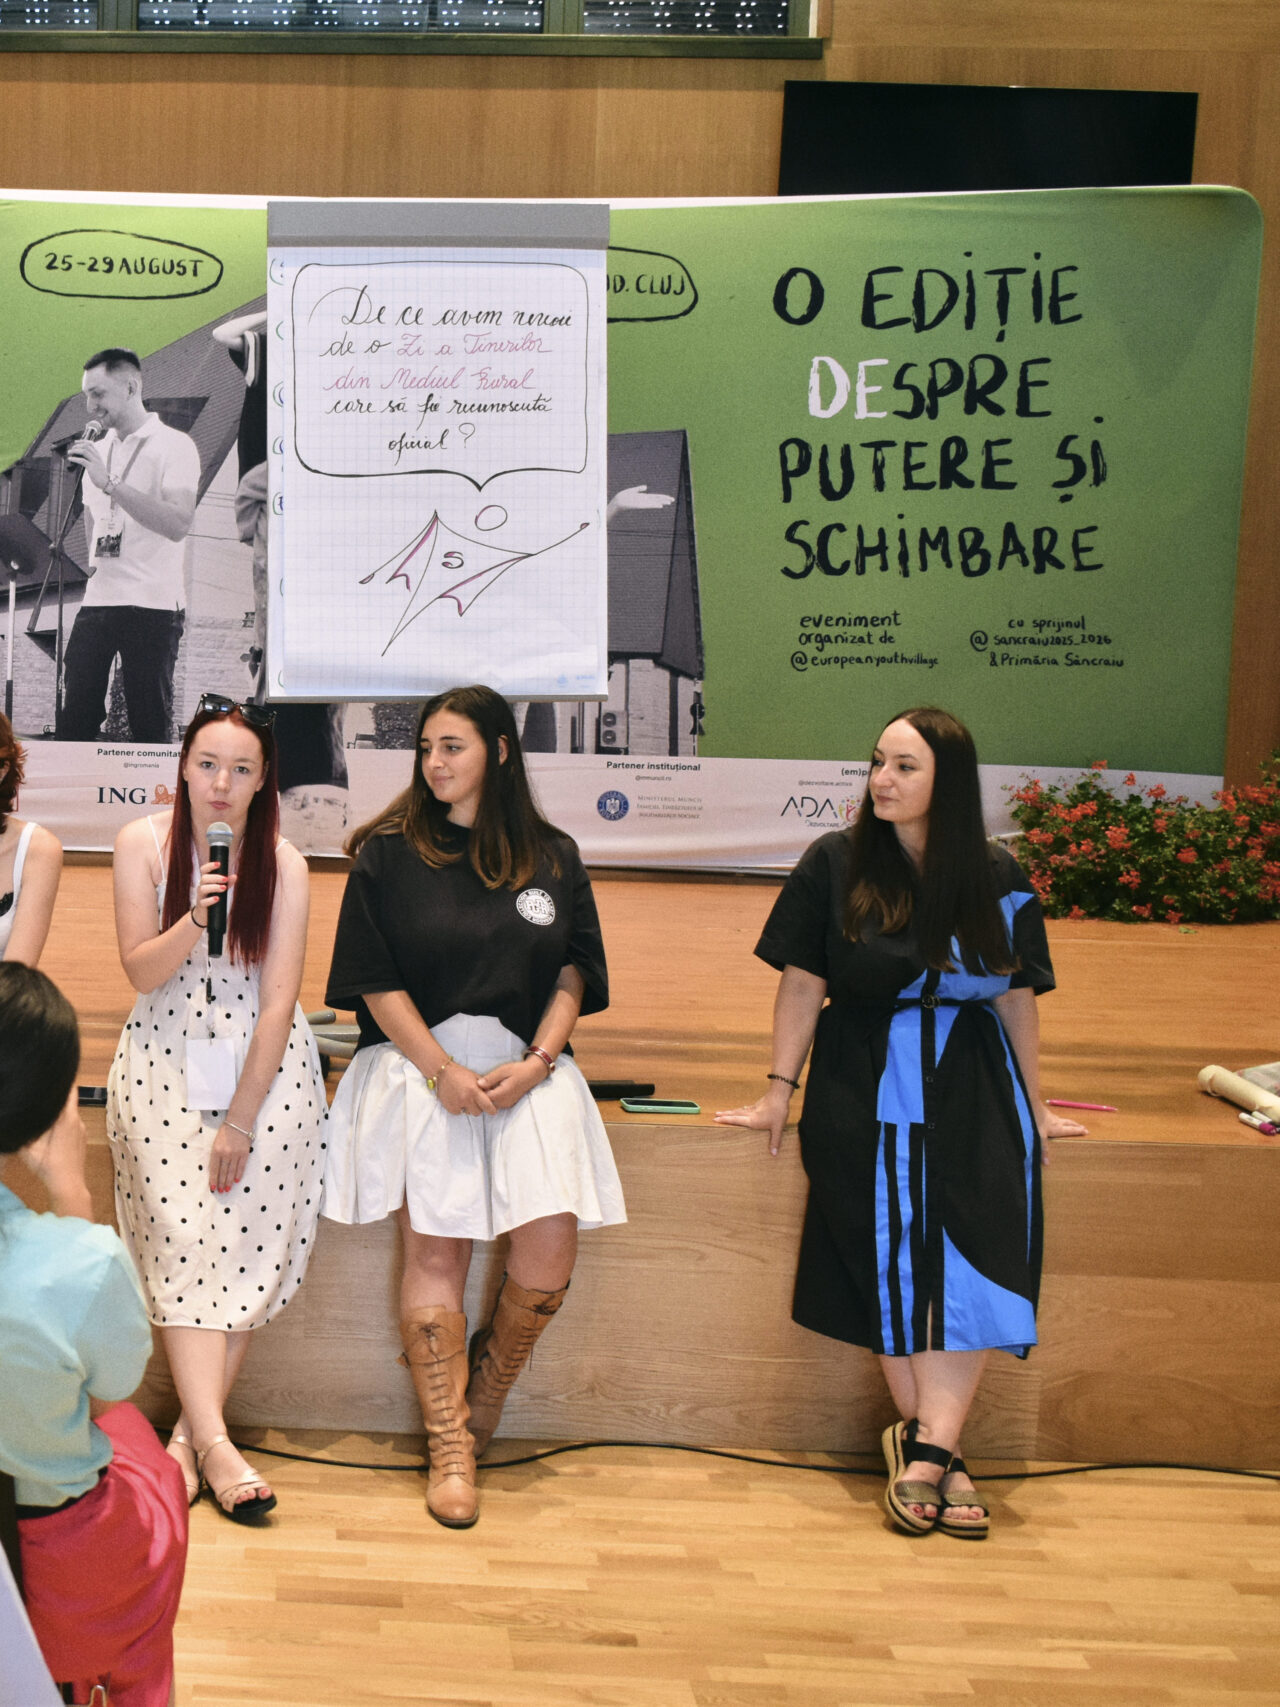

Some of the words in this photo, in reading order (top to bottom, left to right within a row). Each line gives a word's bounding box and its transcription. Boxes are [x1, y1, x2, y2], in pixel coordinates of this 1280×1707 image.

[45, 252, 114, 274] 25-29
[118, 256, 204, 278] AUGUST
[635, 274, 685, 295] CLUJ
[773, 266, 825, 326] O
[861, 250, 1083, 343] EDIȚIE
[308, 284, 386, 327] De
[395, 305, 425, 326] ce
[432, 308, 503, 327] avem
[319, 331, 356, 357] de
[363, 338, 392, 355] o
[396, 332, 424, 356] Zi
[434, 343, 453, 356] a
[463, 331, 553, 355] Tinerilor
[322, 365, 371, 391] din
[380, 365, 467, 390] Mediul
[470, 366, 537, 391] Rural
[808, 353, 1052, 421] DESPRE
[325, 397, 376, 415] care
[380, 396, 408, 414] să
[416, 392, 441, 431] fie
[446, 393, 554, 414] recunoscută
[388, 428, 450, 466] oficial
[458, 422, 476, 449] ?
[778, 435, 1019, 504] PUTERE
[1051, 416, 1107, 504] ȘI
[780, 513, 1105, 580] SCHIMBARE
[799, 610, 902, 628] eveniment
[1008, 618, 1024, 628] cu
[1032, 615, 1086, 633] sprijinul
[798, 631, 874, 652] organizat
[879, 630, 896, 644] de
[1001, 653, 1059, 667] Primăria
[97, 748, 135, 757] Partener
[606, 761, 645, 769] Partener
[647, 762, 701, 772] instituțional
[841, 768, 869, 778] (em)p
[97, 786, 148, 805] ING
[781, 796, 838, 819] ADA
